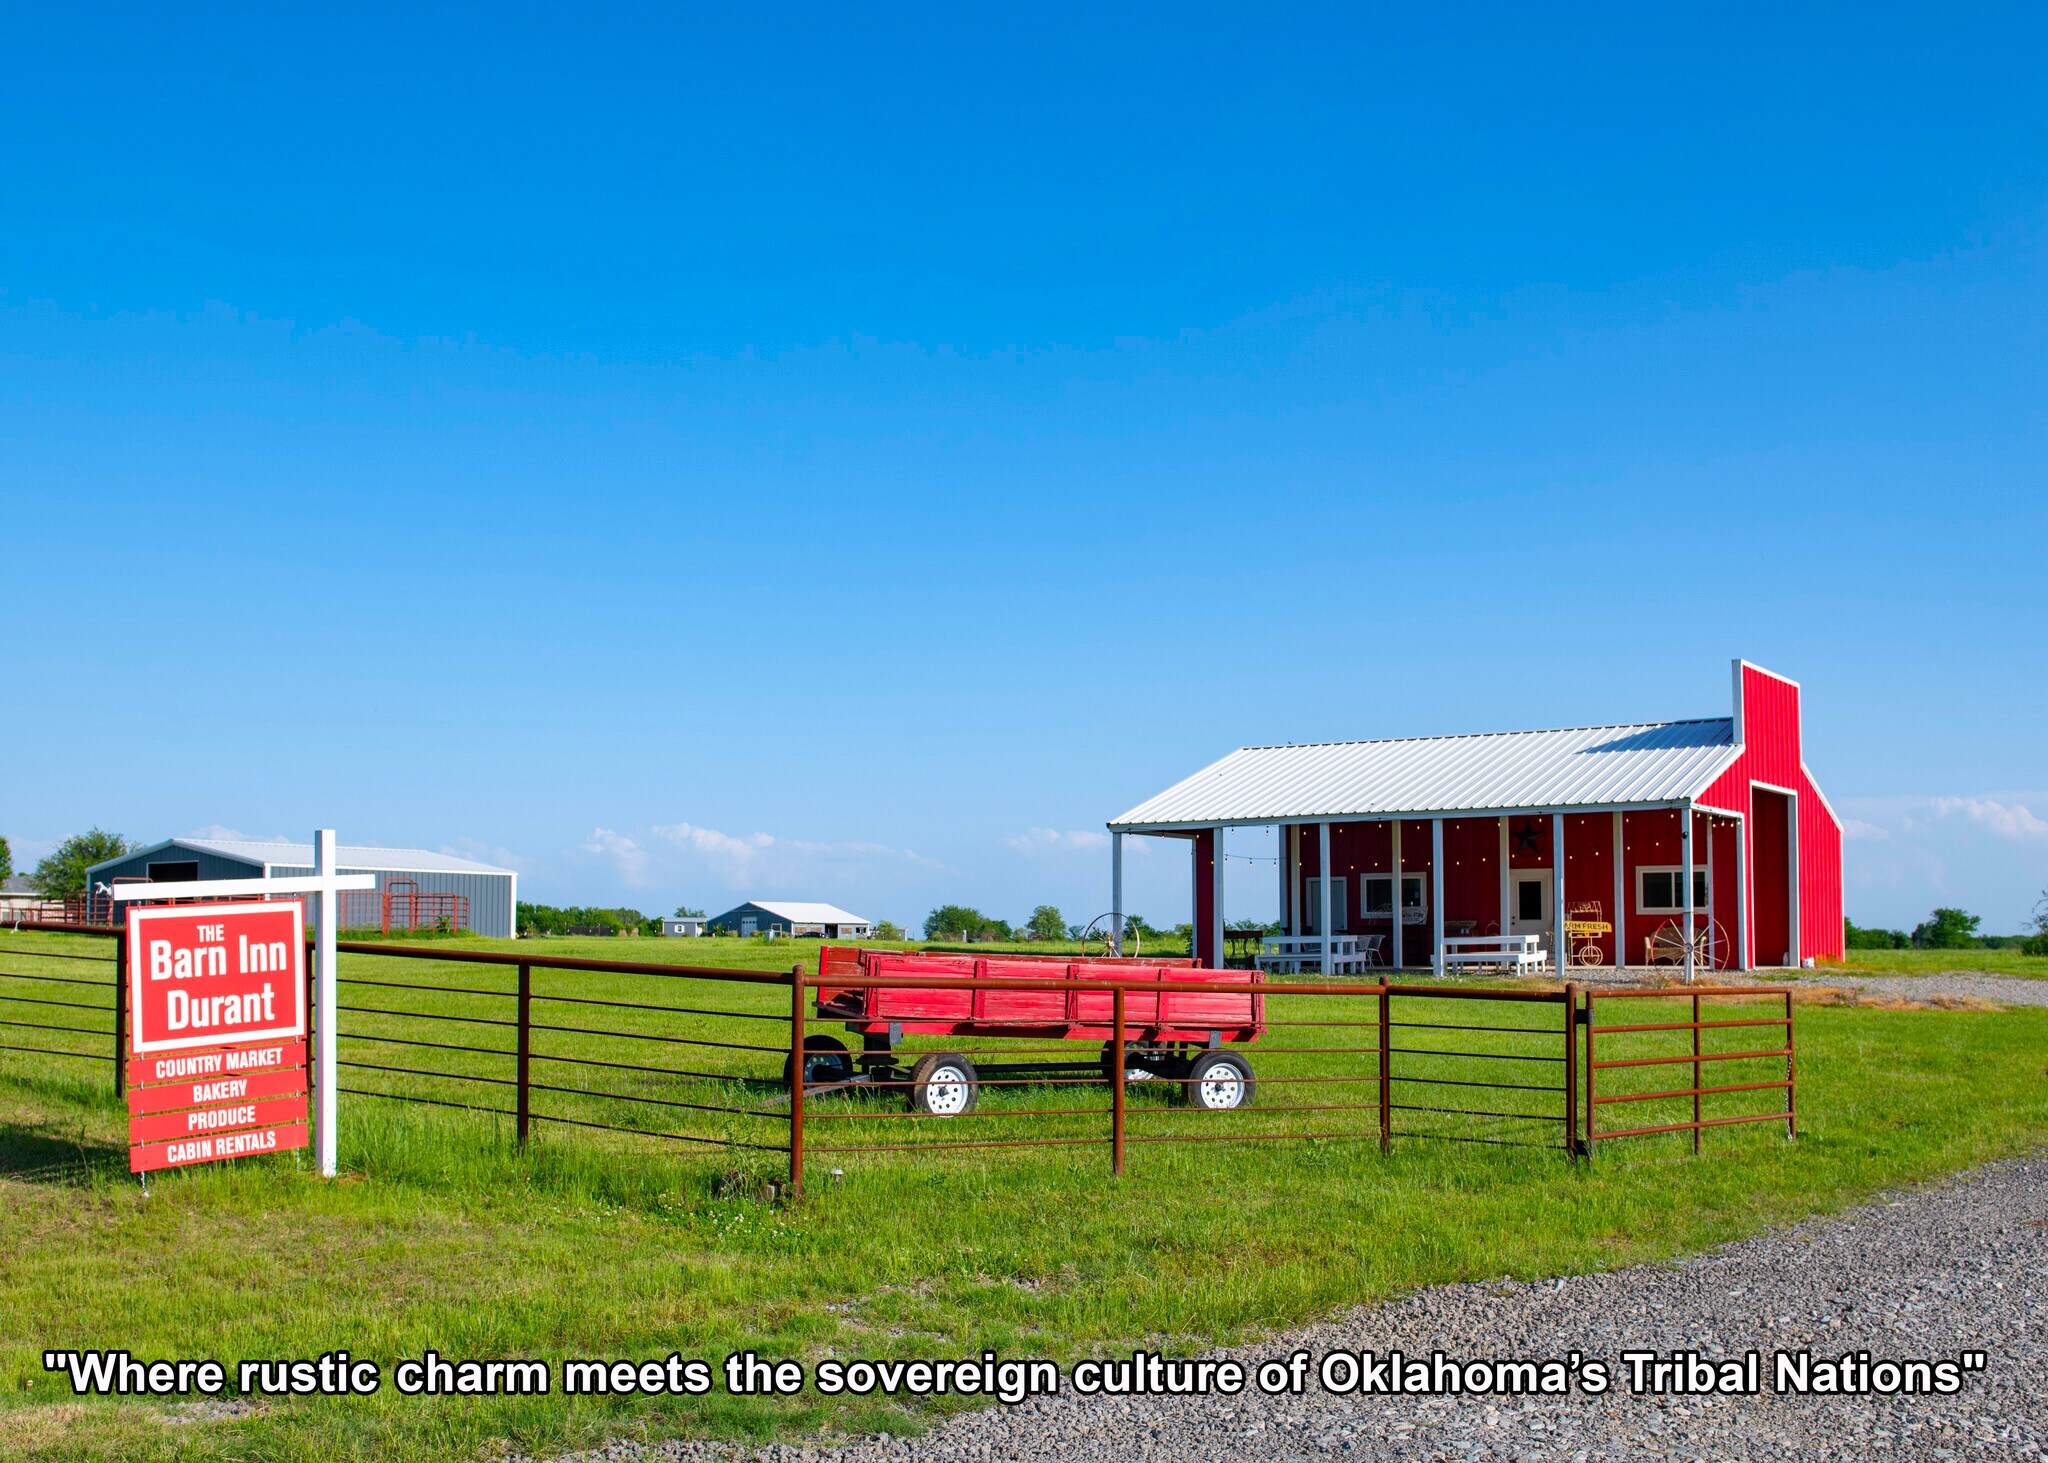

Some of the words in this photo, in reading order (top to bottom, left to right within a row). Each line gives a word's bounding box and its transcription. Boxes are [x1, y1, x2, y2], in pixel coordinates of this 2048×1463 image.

[197, 924, 224, 942] THE
[1583, 922, 1608, 930] FRESH
[150, 940, 226, 980] Barn
[239, 935, 287, 974] Inn
[167, 983, 275, 1030] Durant
[156, 1055, 221, 1079] COUNTRY
[226, 1047, 283, 1070] MARKET
[193, 1079, 247, 1103] BAKERY
[188, 1106, 256, 1131] PRODUCE
[167, 1139, 212, 1163] CABIN
[216, 1131, 276, 1156] RENTALS
